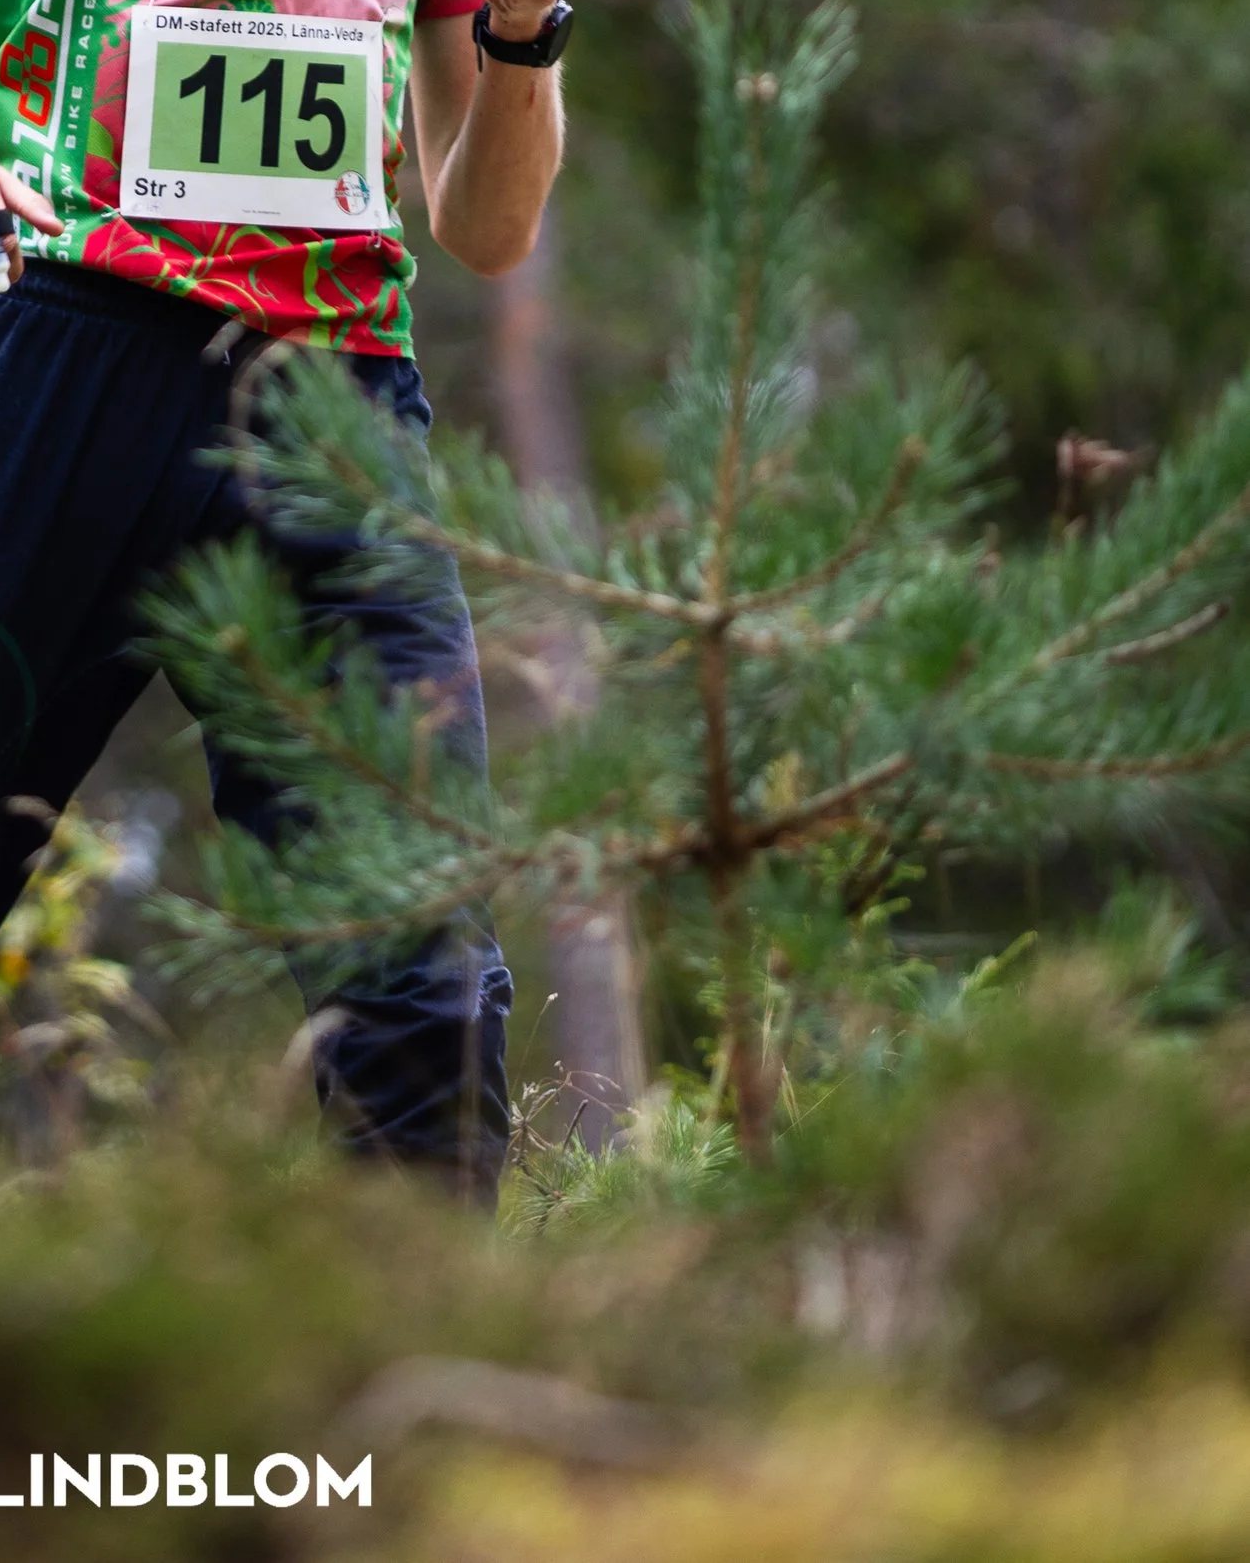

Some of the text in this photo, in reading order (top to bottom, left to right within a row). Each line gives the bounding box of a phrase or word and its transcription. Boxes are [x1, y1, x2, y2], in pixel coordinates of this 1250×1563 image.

[156, 15, 363, 41] DM-stafett 2025, Länna-Veda
[65, 85, 83, 149] BIKE
[180, 55, 346, 171] 115
[134, 178, 186, 198] Str 3
